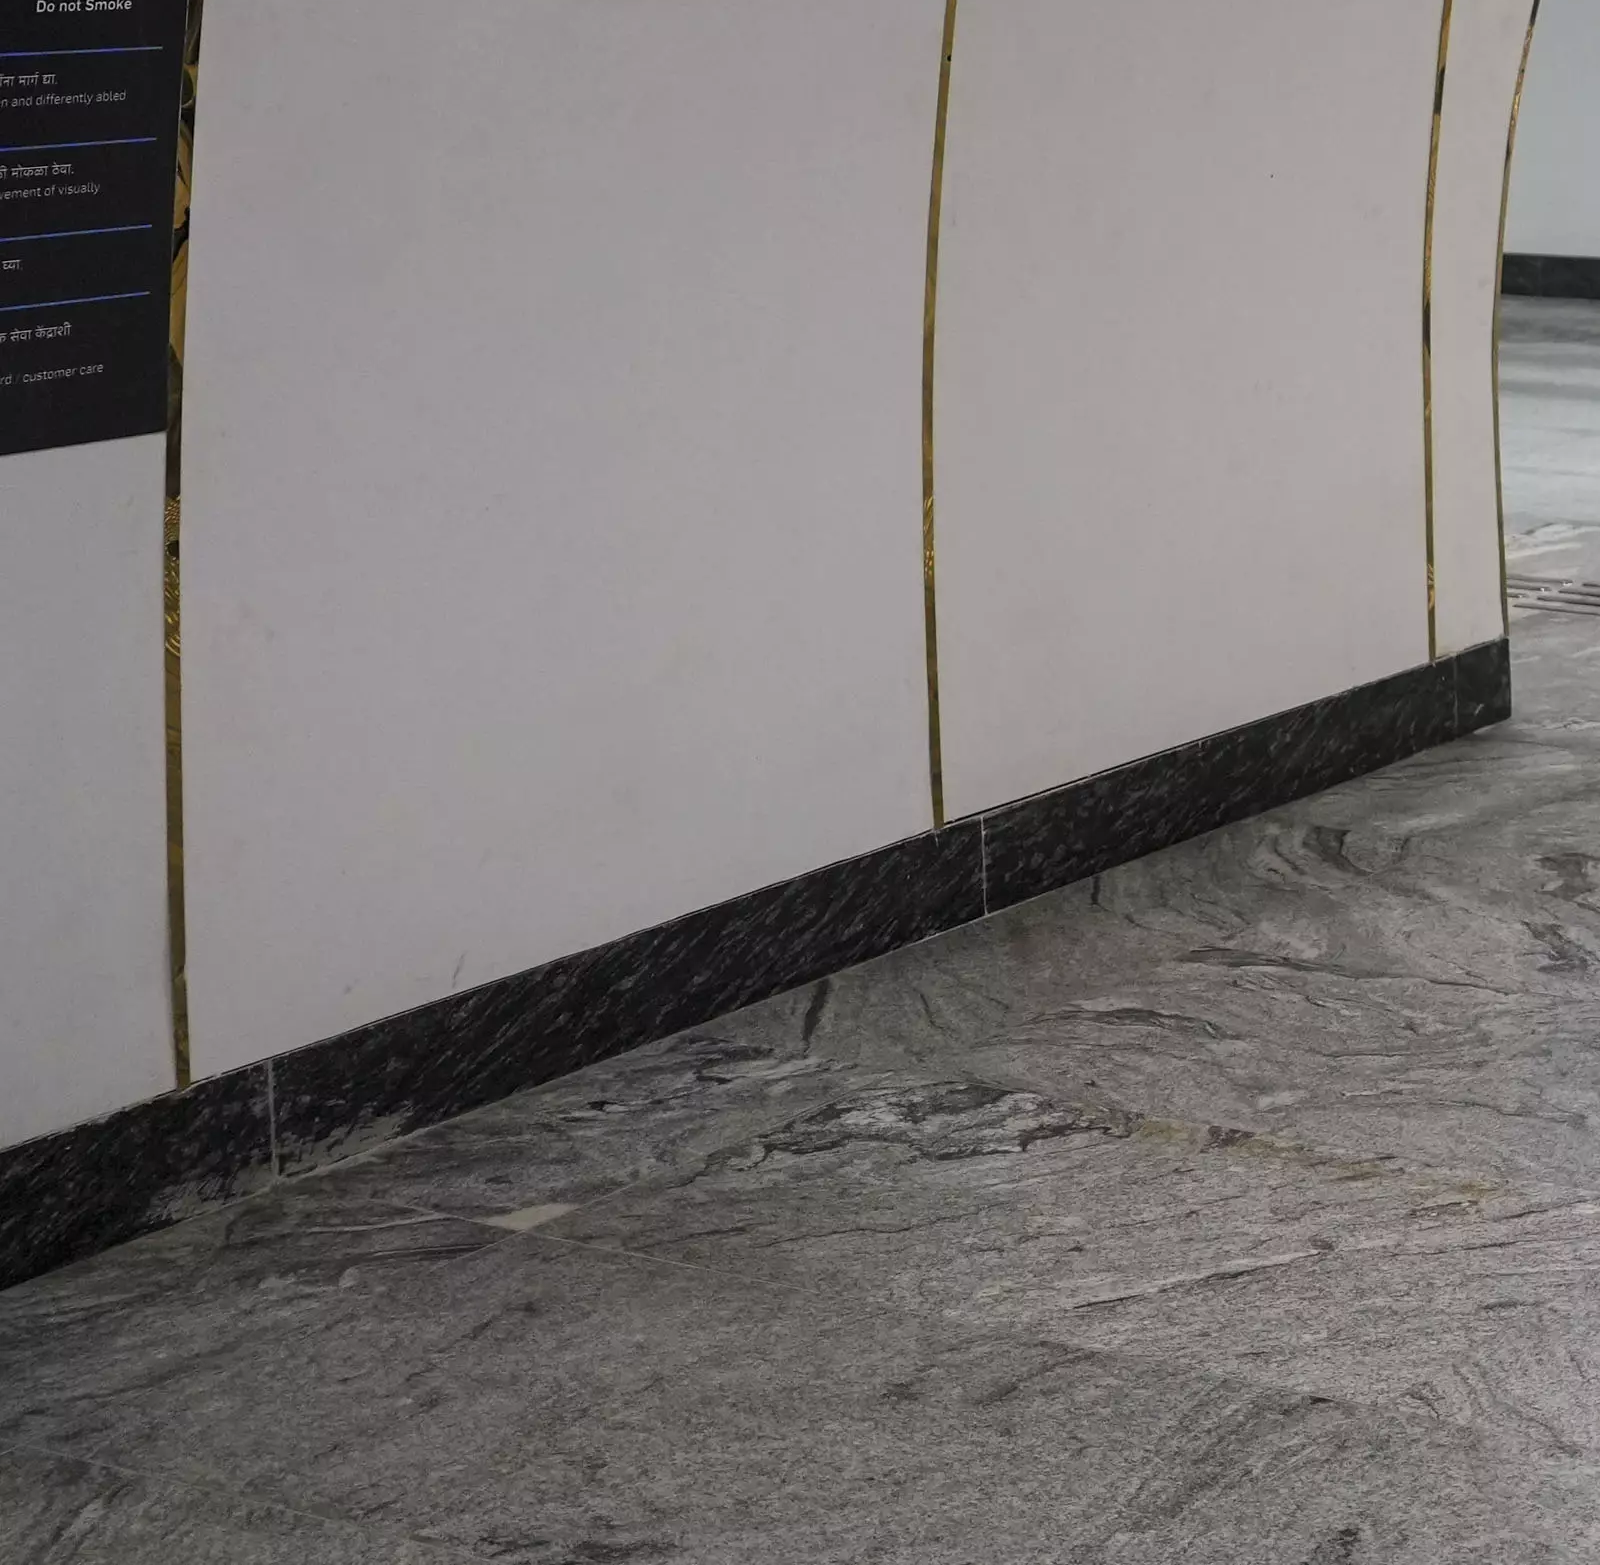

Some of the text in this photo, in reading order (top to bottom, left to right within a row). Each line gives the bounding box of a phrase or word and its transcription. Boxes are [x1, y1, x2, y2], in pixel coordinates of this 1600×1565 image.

[36, 0, 55, 13] Do
[59, 0, 82, 12] not
[11, 89, 126, 107] and differently abled
[44, 184, 56, 196] of
[58, 181, 101, 195] visually
[23, 363, 104, 383] customer care
